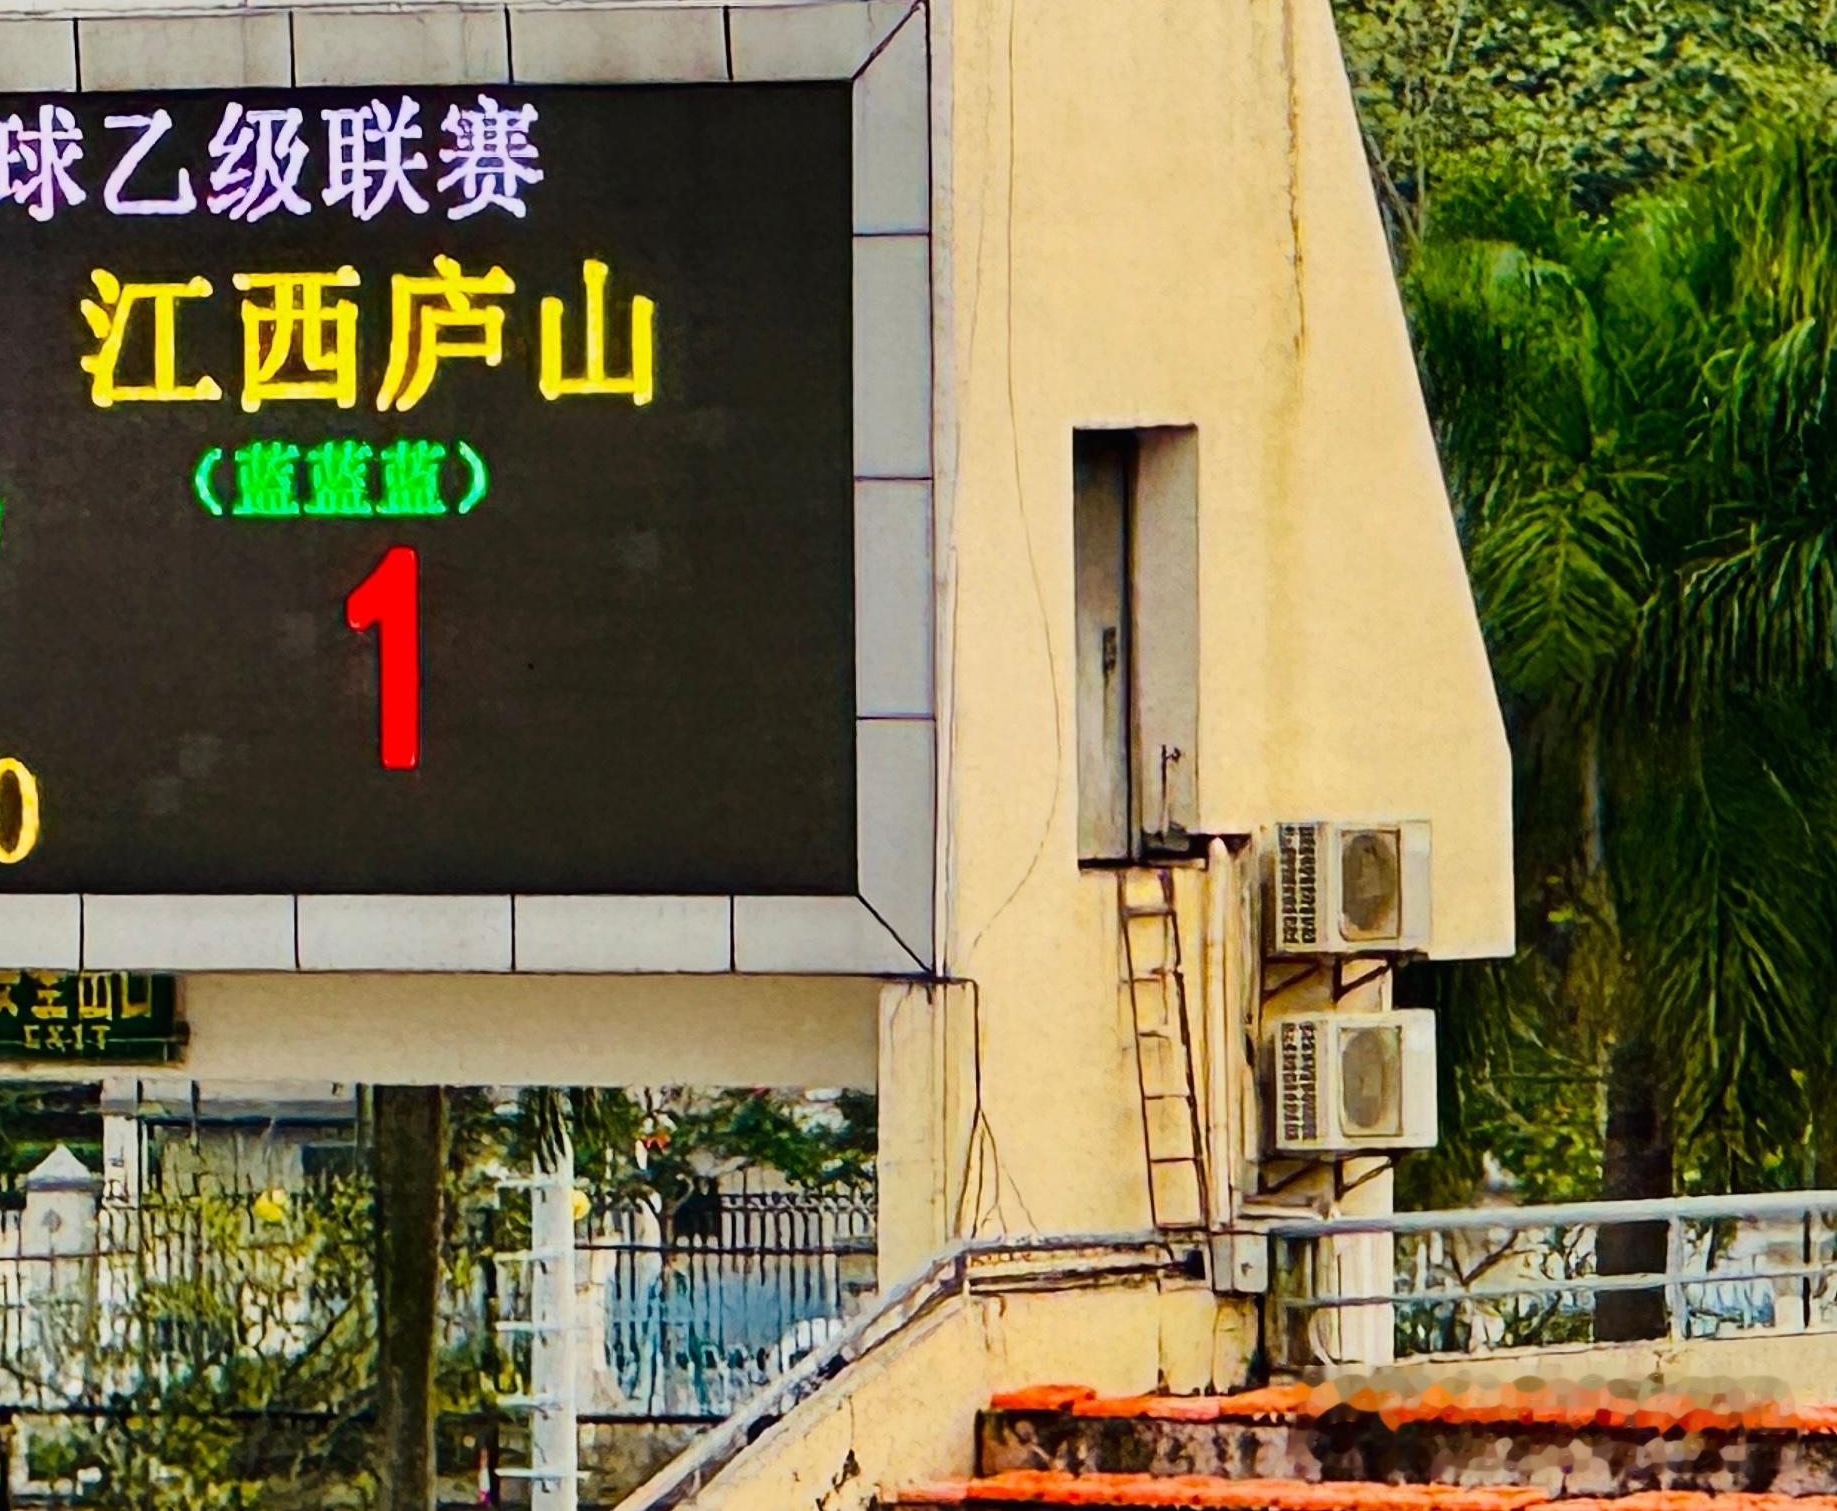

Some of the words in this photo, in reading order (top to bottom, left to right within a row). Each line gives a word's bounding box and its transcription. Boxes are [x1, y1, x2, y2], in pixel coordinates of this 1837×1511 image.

[82, 255, 654, 411] 江西庐山
[347, 547, 418, 769] 1
[23, 1025, 111, 1051] EXIT
